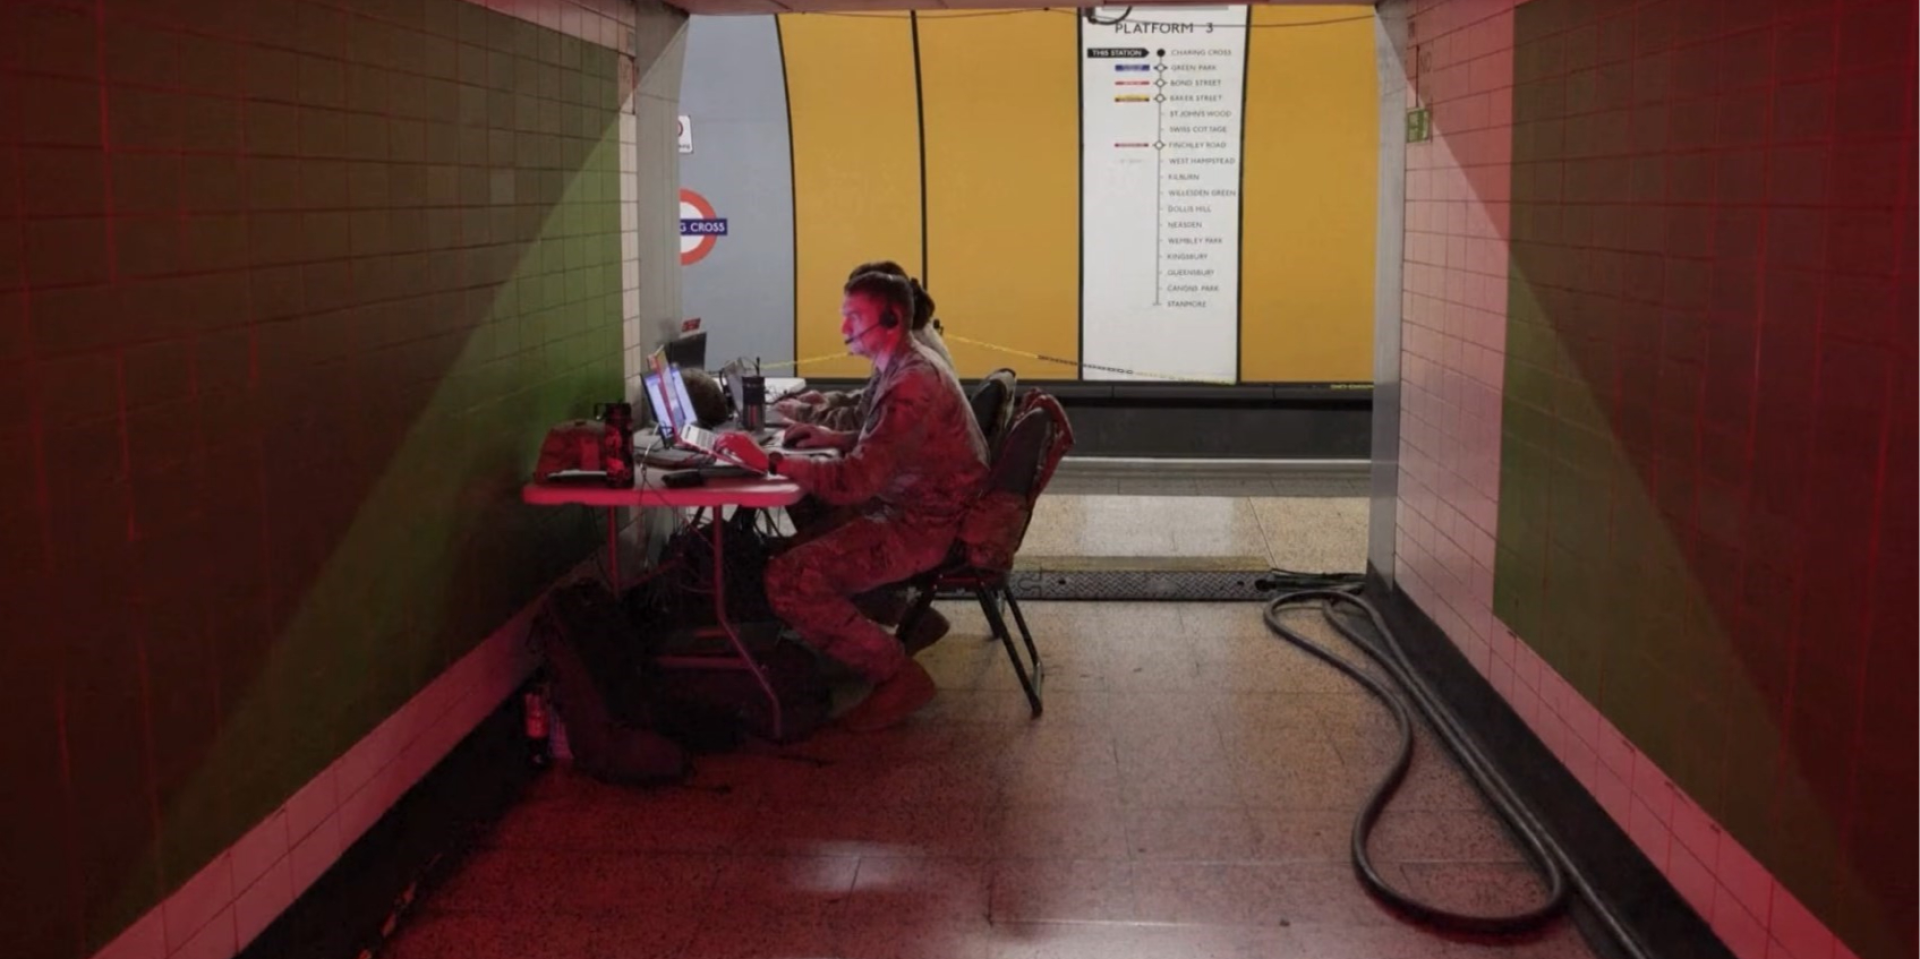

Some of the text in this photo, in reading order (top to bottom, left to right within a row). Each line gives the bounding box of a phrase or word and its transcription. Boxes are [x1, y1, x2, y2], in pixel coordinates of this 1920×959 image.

[1114, 22, 1214, 34] PLATFORM 3
[1091, 49, 1143, 57] THIS STATION
[1169, 125, 1227, 133] SWISS COTTAGE
[1169, 141, 1227, 149] FINCHLEY ROAD
[1168, 157, 1236, 165] WEST HAMPSTEAD
[1168, 173, 1200, 181] KILBURN
[1168, 189, 1236, 197] WILLESDEN GREEN
[1167, 205, 1212, 213] DOLLIS HILL
[690, 222, 725, 232] CROSS
[1167, 221, 1202, 229] NEASDEN
[1167, 237, 1223, 245] WEMBLEY PARK
[1167, 253, 1208, 261] KINGSBURY
[1167, 269, 1215, 277] QUEENSBURY
[1167, 285, 1219, 293] CANONS PARK
[1167, 300, 1207, 308] STANMORE
